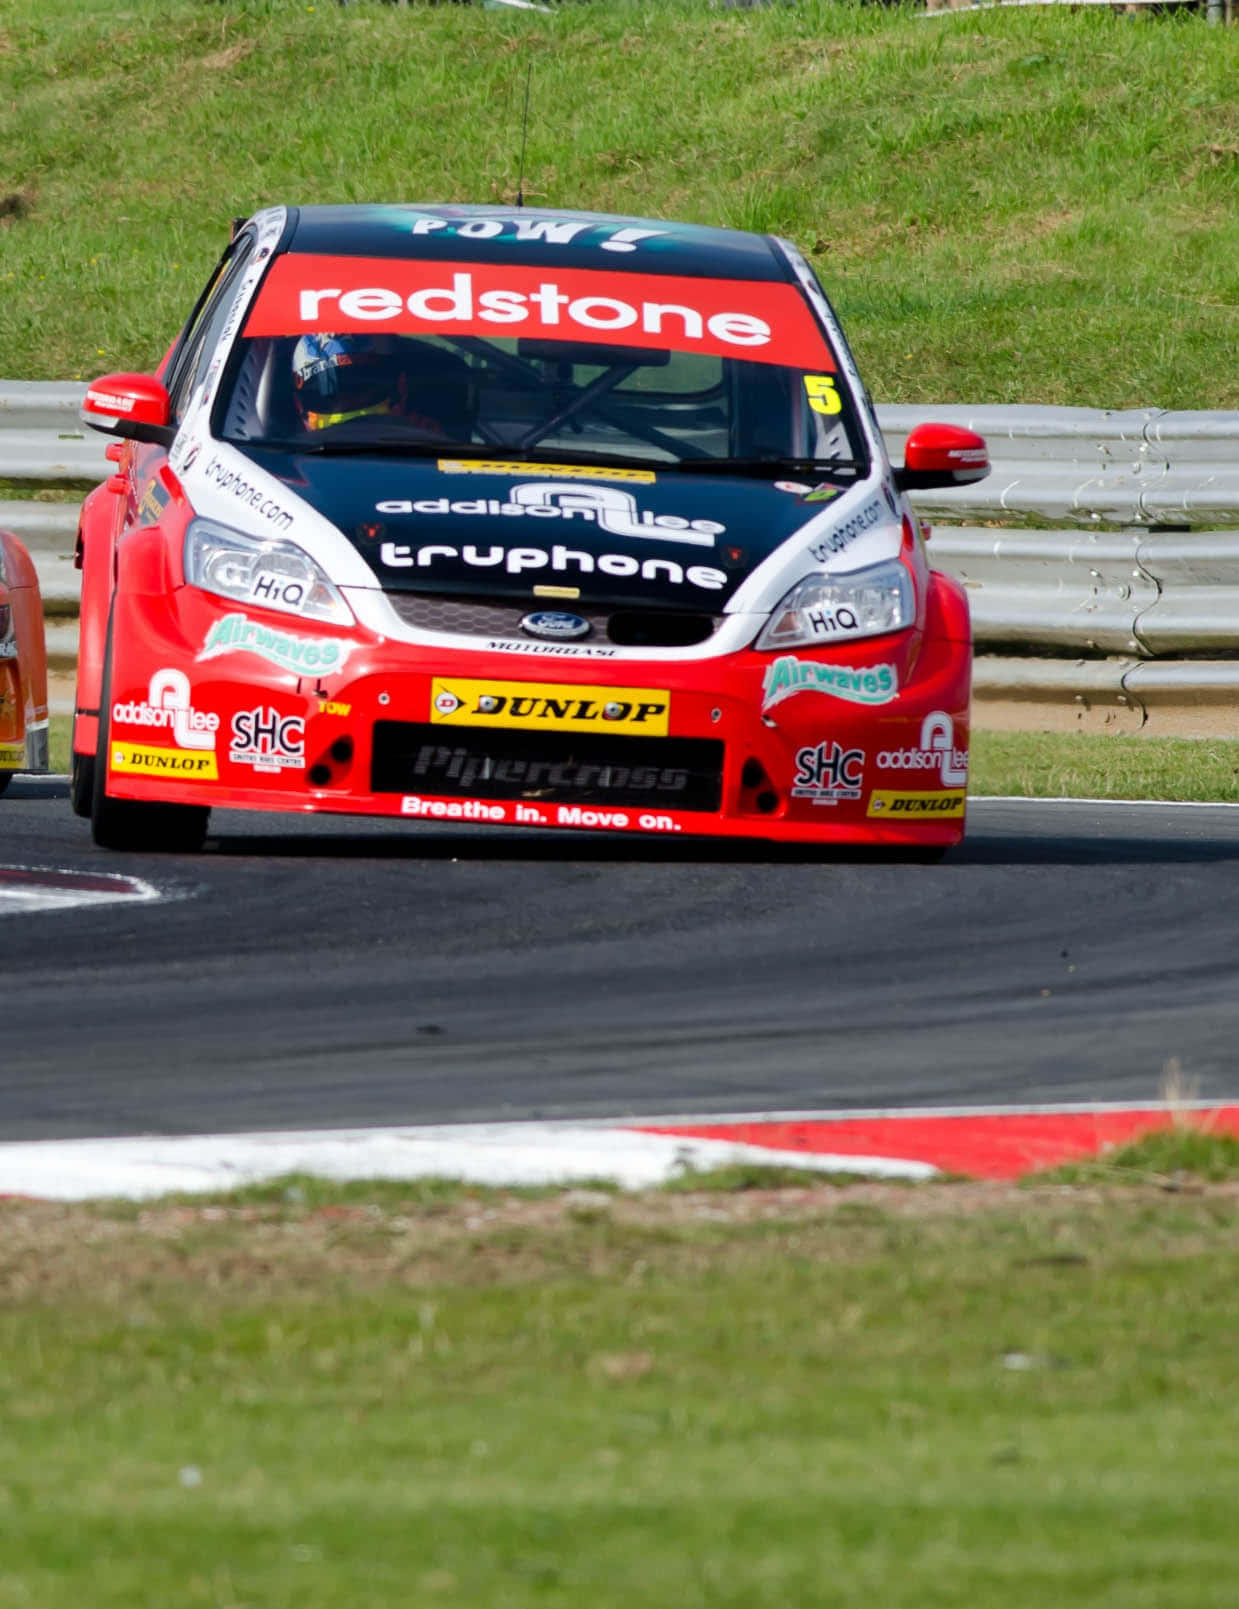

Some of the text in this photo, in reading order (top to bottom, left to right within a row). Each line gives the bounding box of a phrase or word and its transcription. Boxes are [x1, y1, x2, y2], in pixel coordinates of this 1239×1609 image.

[412, 218, 670, 252] POW!
[299, 272, 772, 347] redstone
[803, 375, 842, 415] 5
[205, 453, 295, 531] truphone.com
[375, 498, 595, 521] addison
[380, 542, 728, 590] truphone
[254, 576, 304, 606] HiQ
[808, 607, 859, 634] HiQ
[204, 614, 340, 666] Airwaves
[766, 658, 893, 696] Airwaves
[113, 701, 220, 732] addison lee
[318, 700, 352, 716] TOW
[471, 694, 667, 722] DUNLOP
[234, 709, 304, 755] SHC
[130, 752, 211, 771] DUNLOP
[797, 746, 864, 787] SHC
[876, 748, 942, 769] addison
[401, 796, 682, 832] Breathe in. Move on.
[889, 797, 963, 812] DUNLOP
